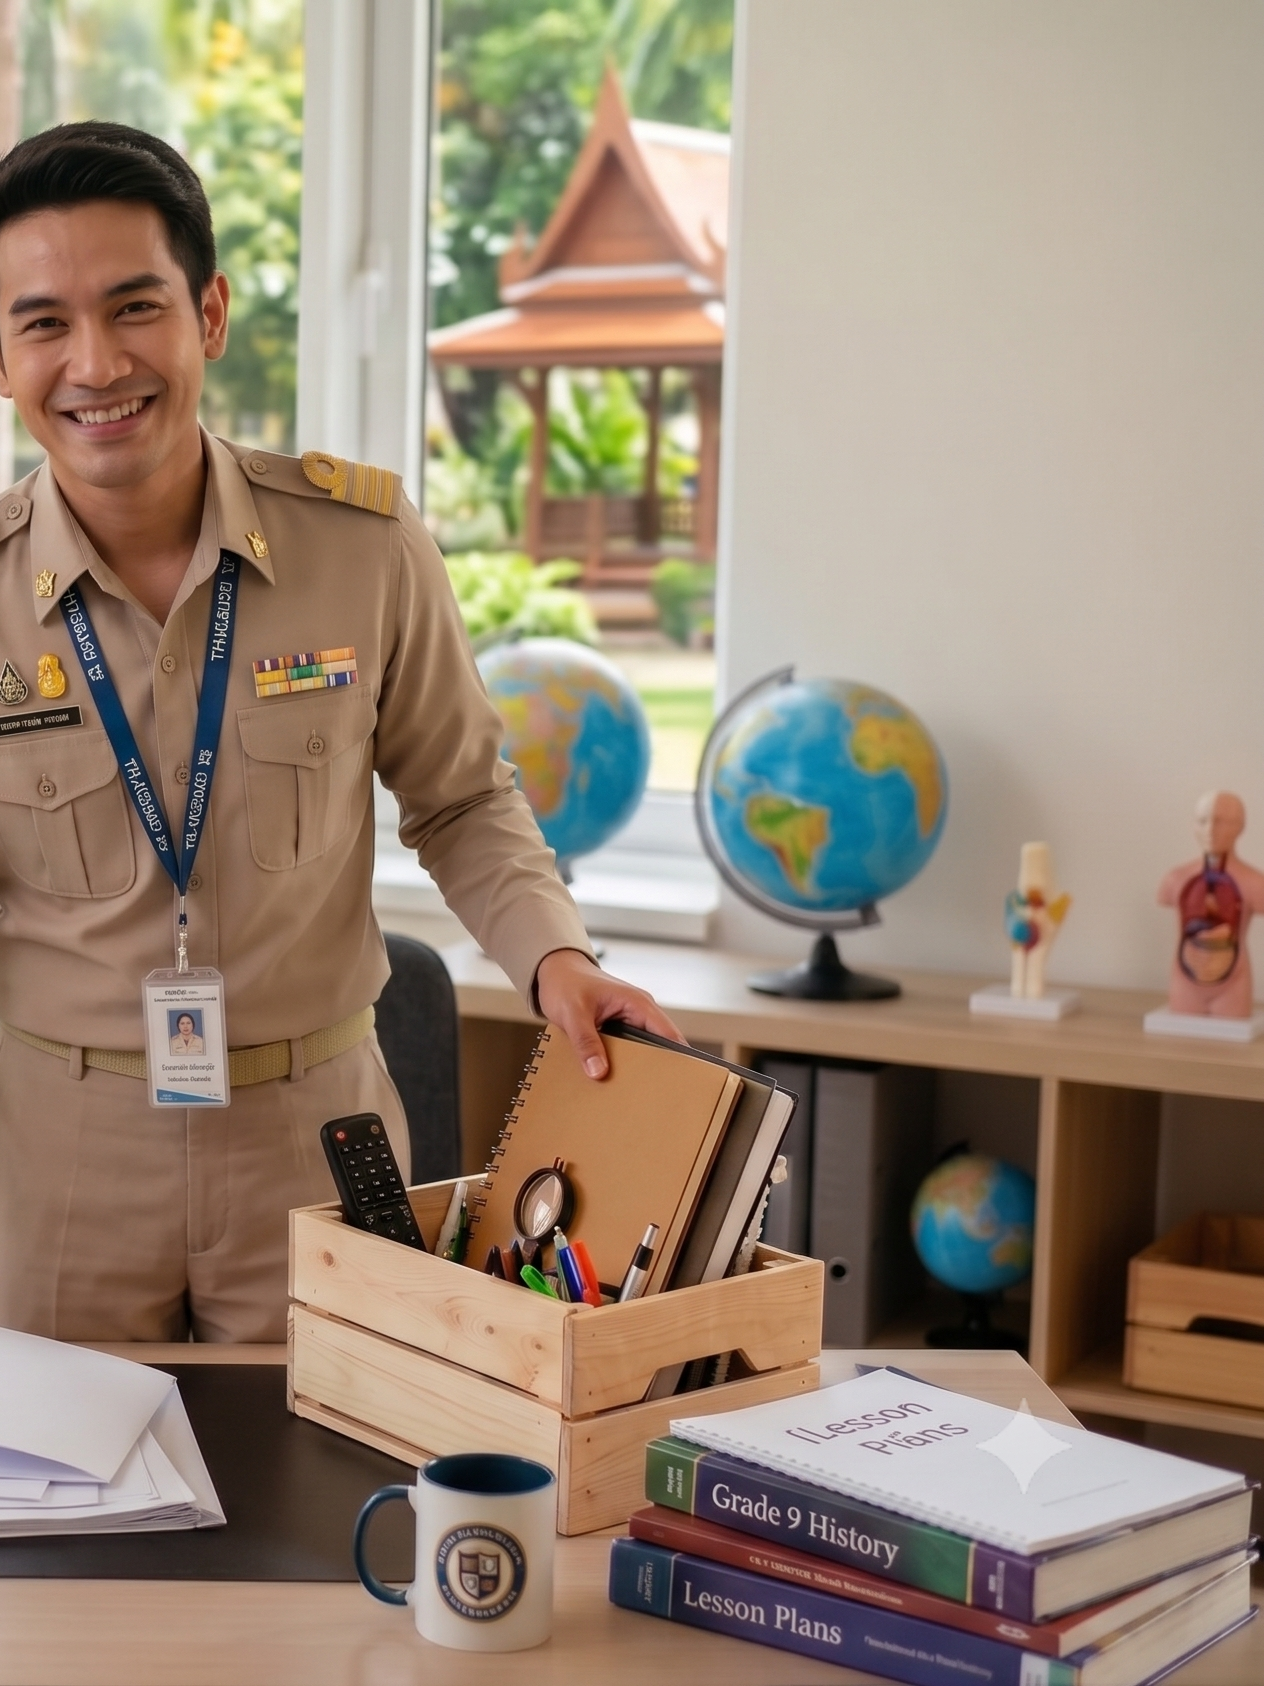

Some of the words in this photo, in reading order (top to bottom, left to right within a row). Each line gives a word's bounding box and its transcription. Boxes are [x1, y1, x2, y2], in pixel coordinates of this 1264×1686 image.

[712, 1483, 782, 1527] Grade
[786, 1506, 802, 1529] 9
[807, 1511, 900, 1569] History
[683, 1580, 767, 1626] Lesson
[773, 1604, 843, 1645] Plans
